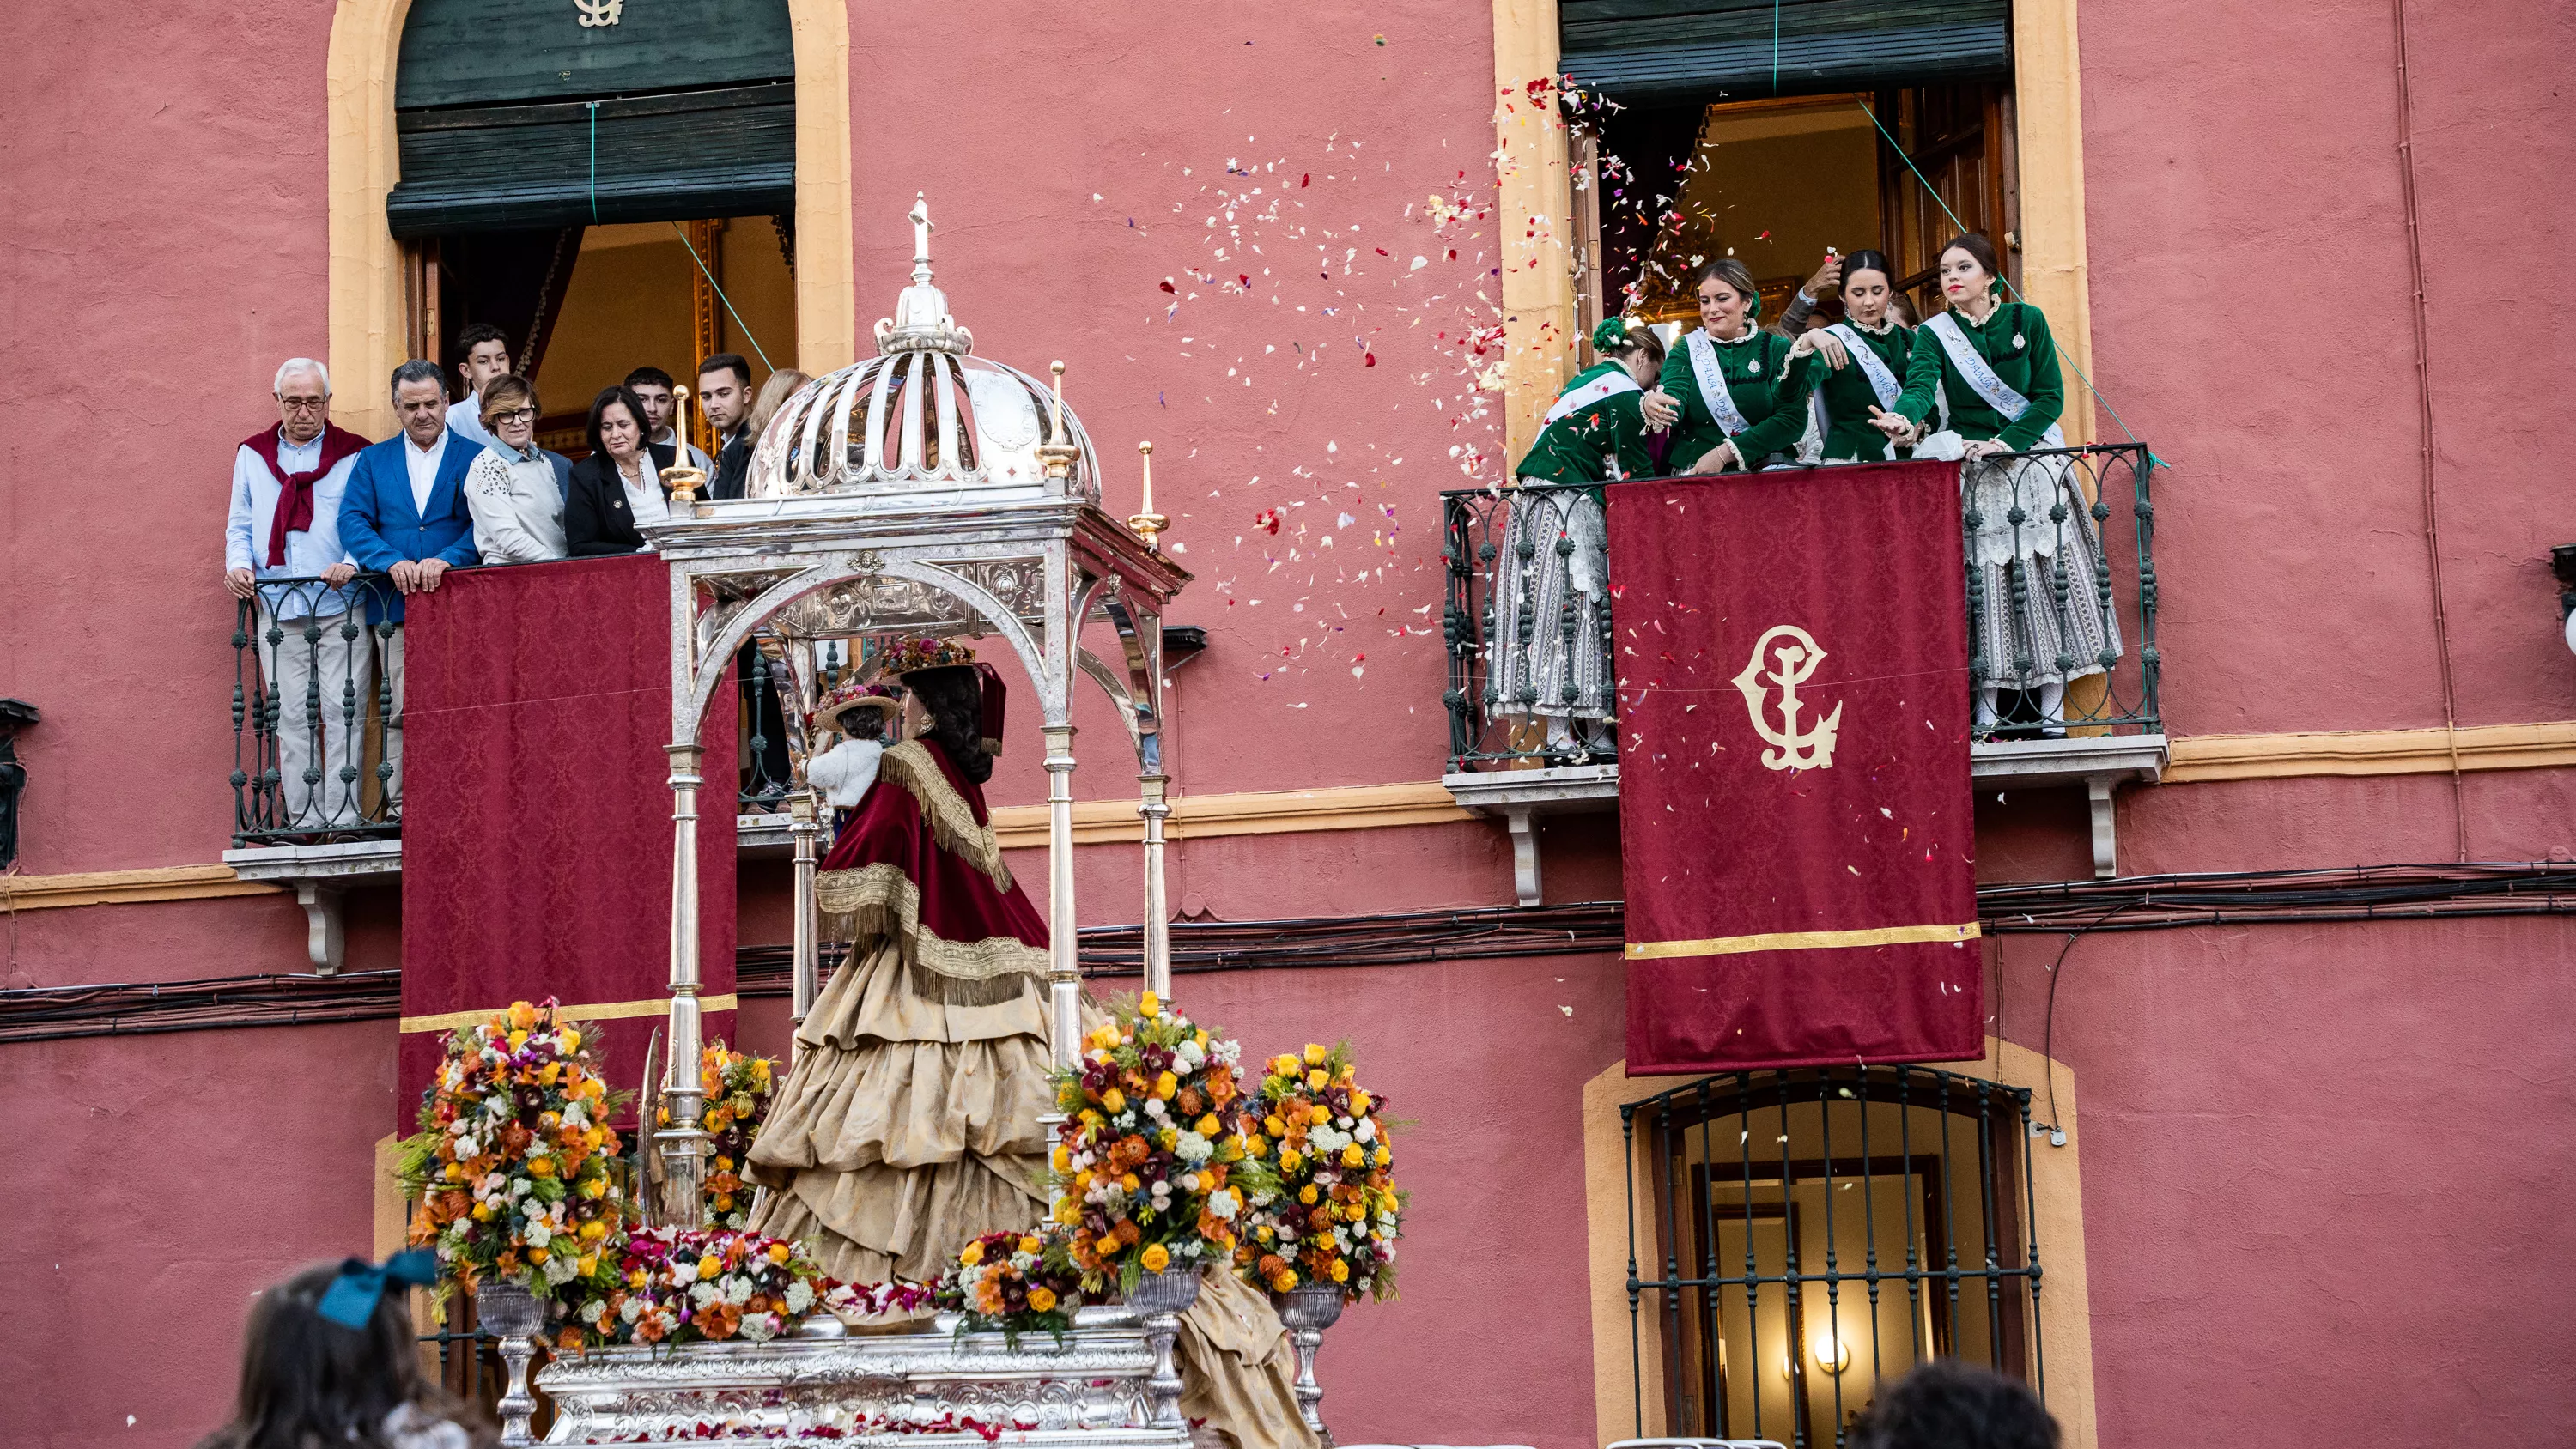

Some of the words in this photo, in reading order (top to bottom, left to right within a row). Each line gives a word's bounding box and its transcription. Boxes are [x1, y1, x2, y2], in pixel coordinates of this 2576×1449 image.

[1701, 359, 1717, 389] DAMA
[1716, 398, 1730, 417] DE
[1868, 361, 1893, 394] DAMA
[1965, 356, 1992, 389] DAMA
[1997, 391, 2015, 406] DE
